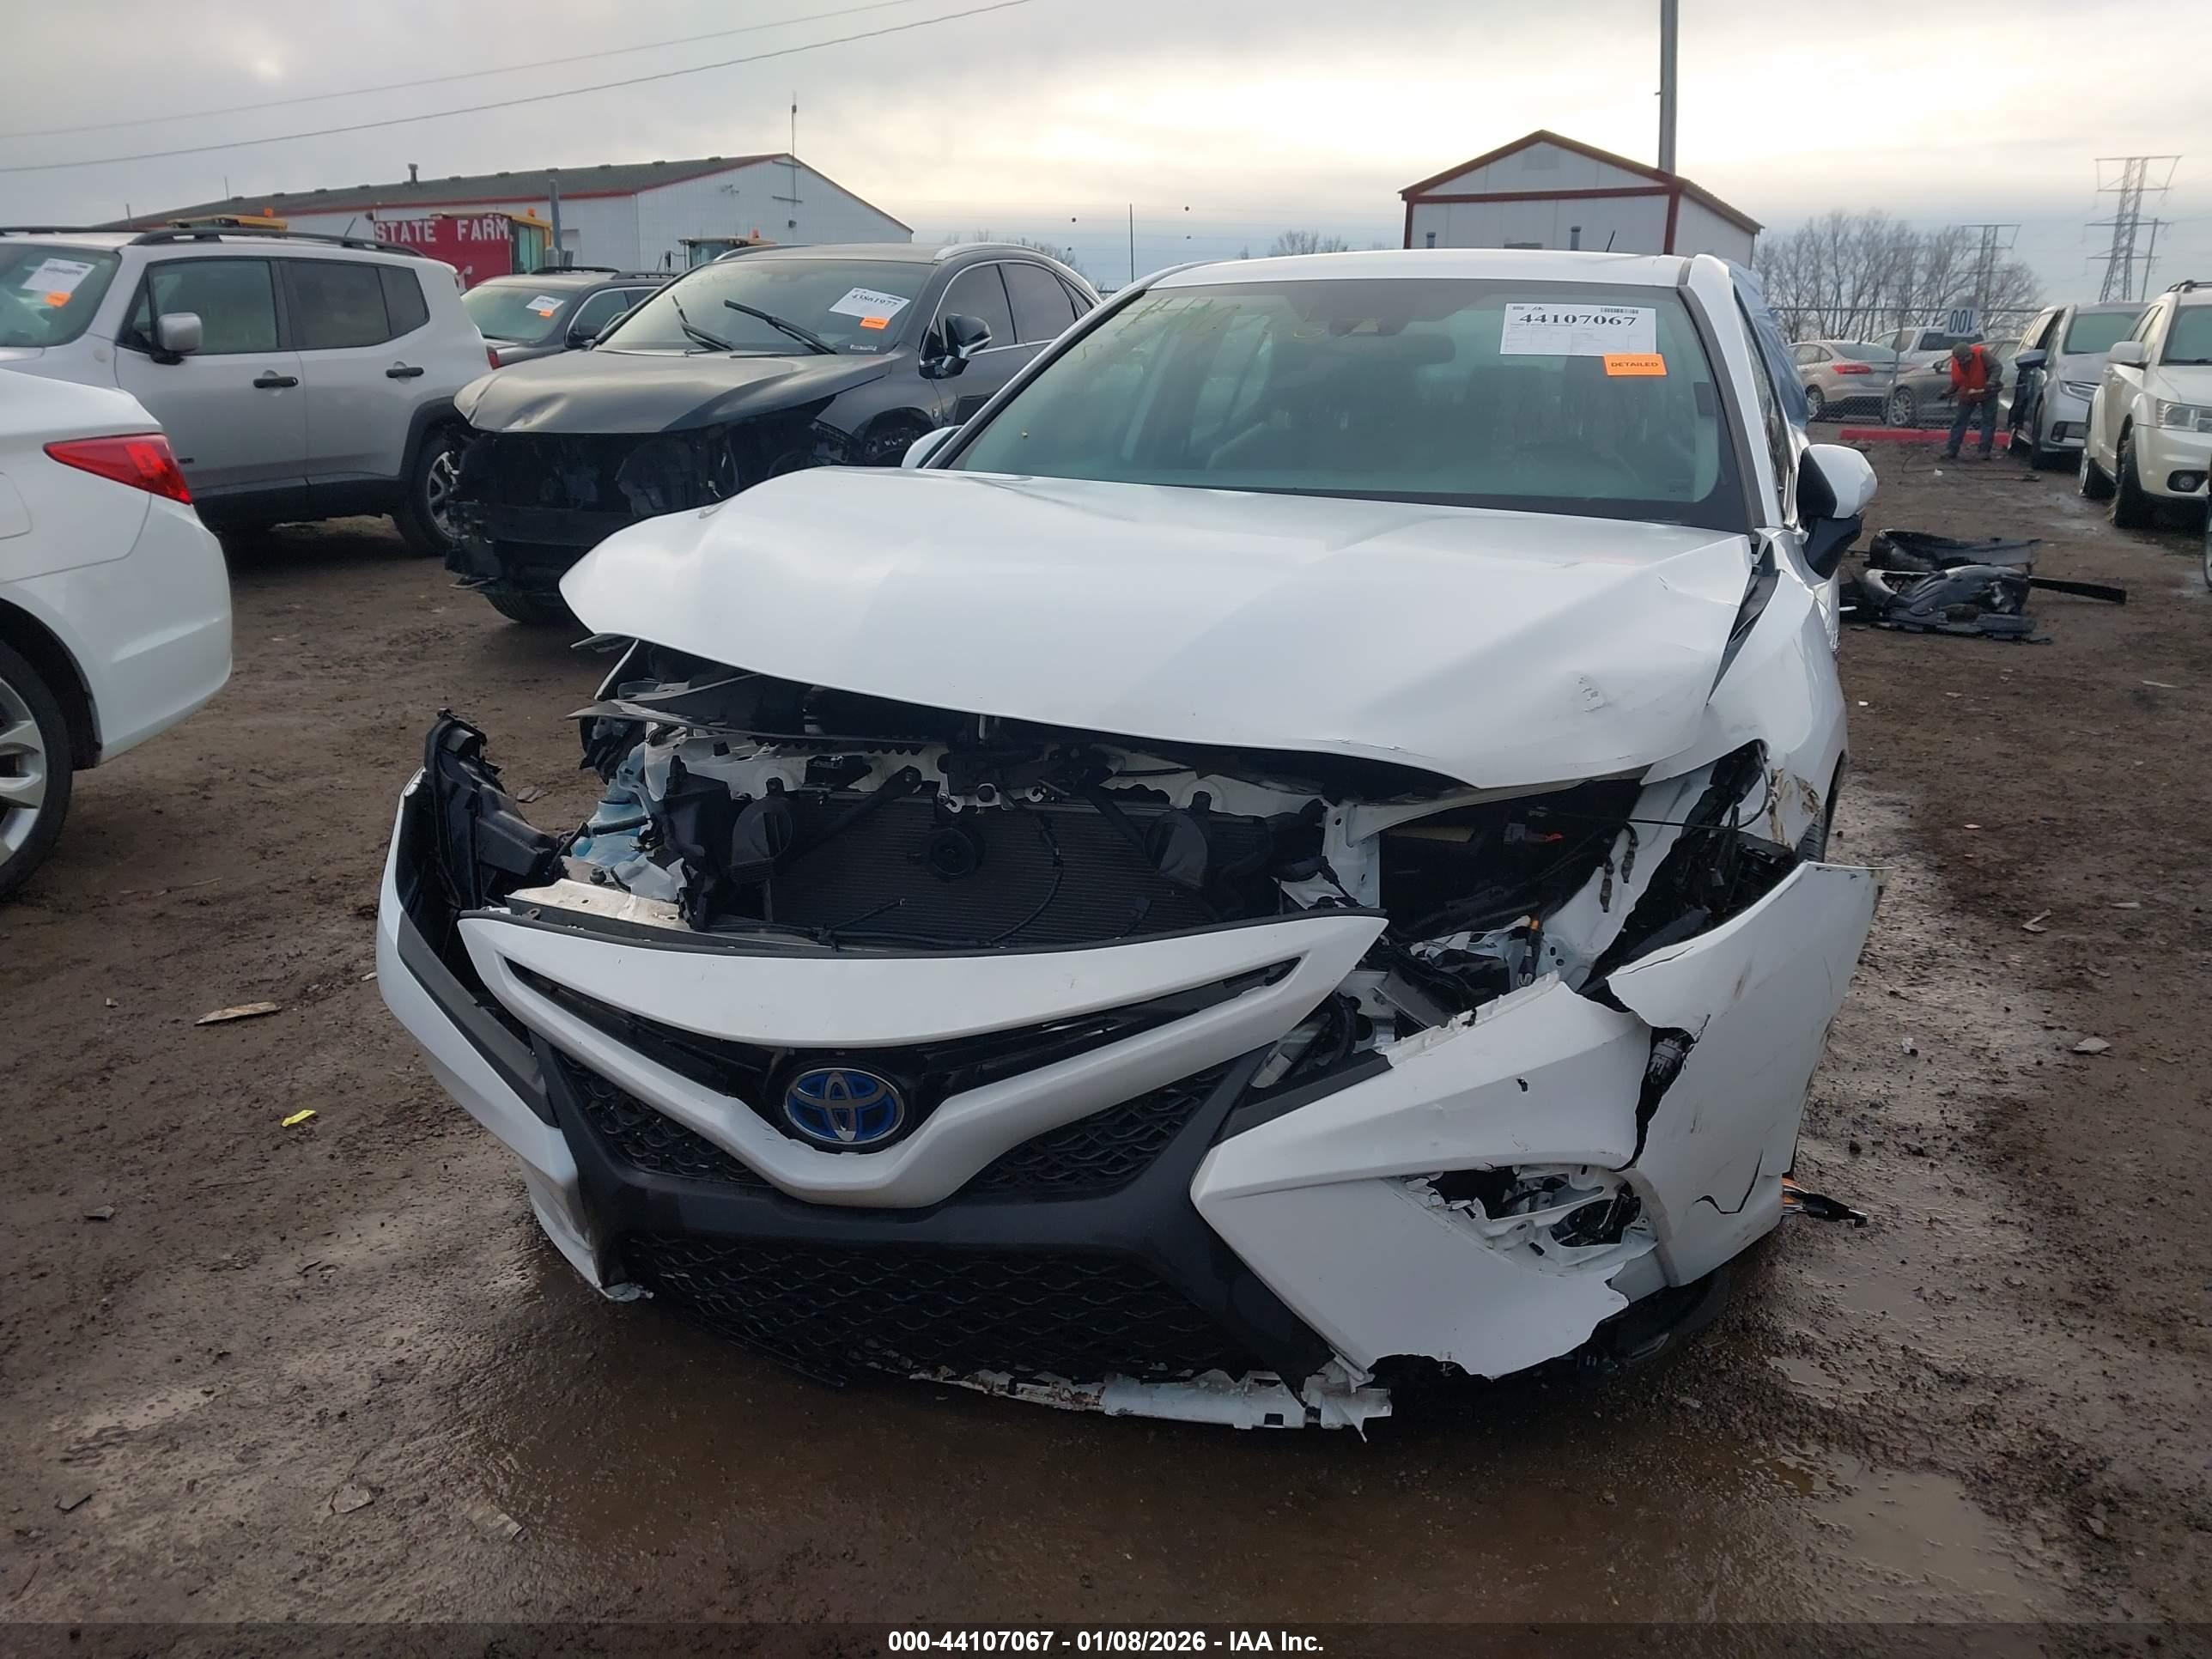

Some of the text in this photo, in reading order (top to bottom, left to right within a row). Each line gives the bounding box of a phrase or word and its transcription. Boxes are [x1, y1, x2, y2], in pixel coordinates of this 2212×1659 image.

[374, 218, 509, 243] STATE FARM
[1519, 313, 1637, 326] 44107067
